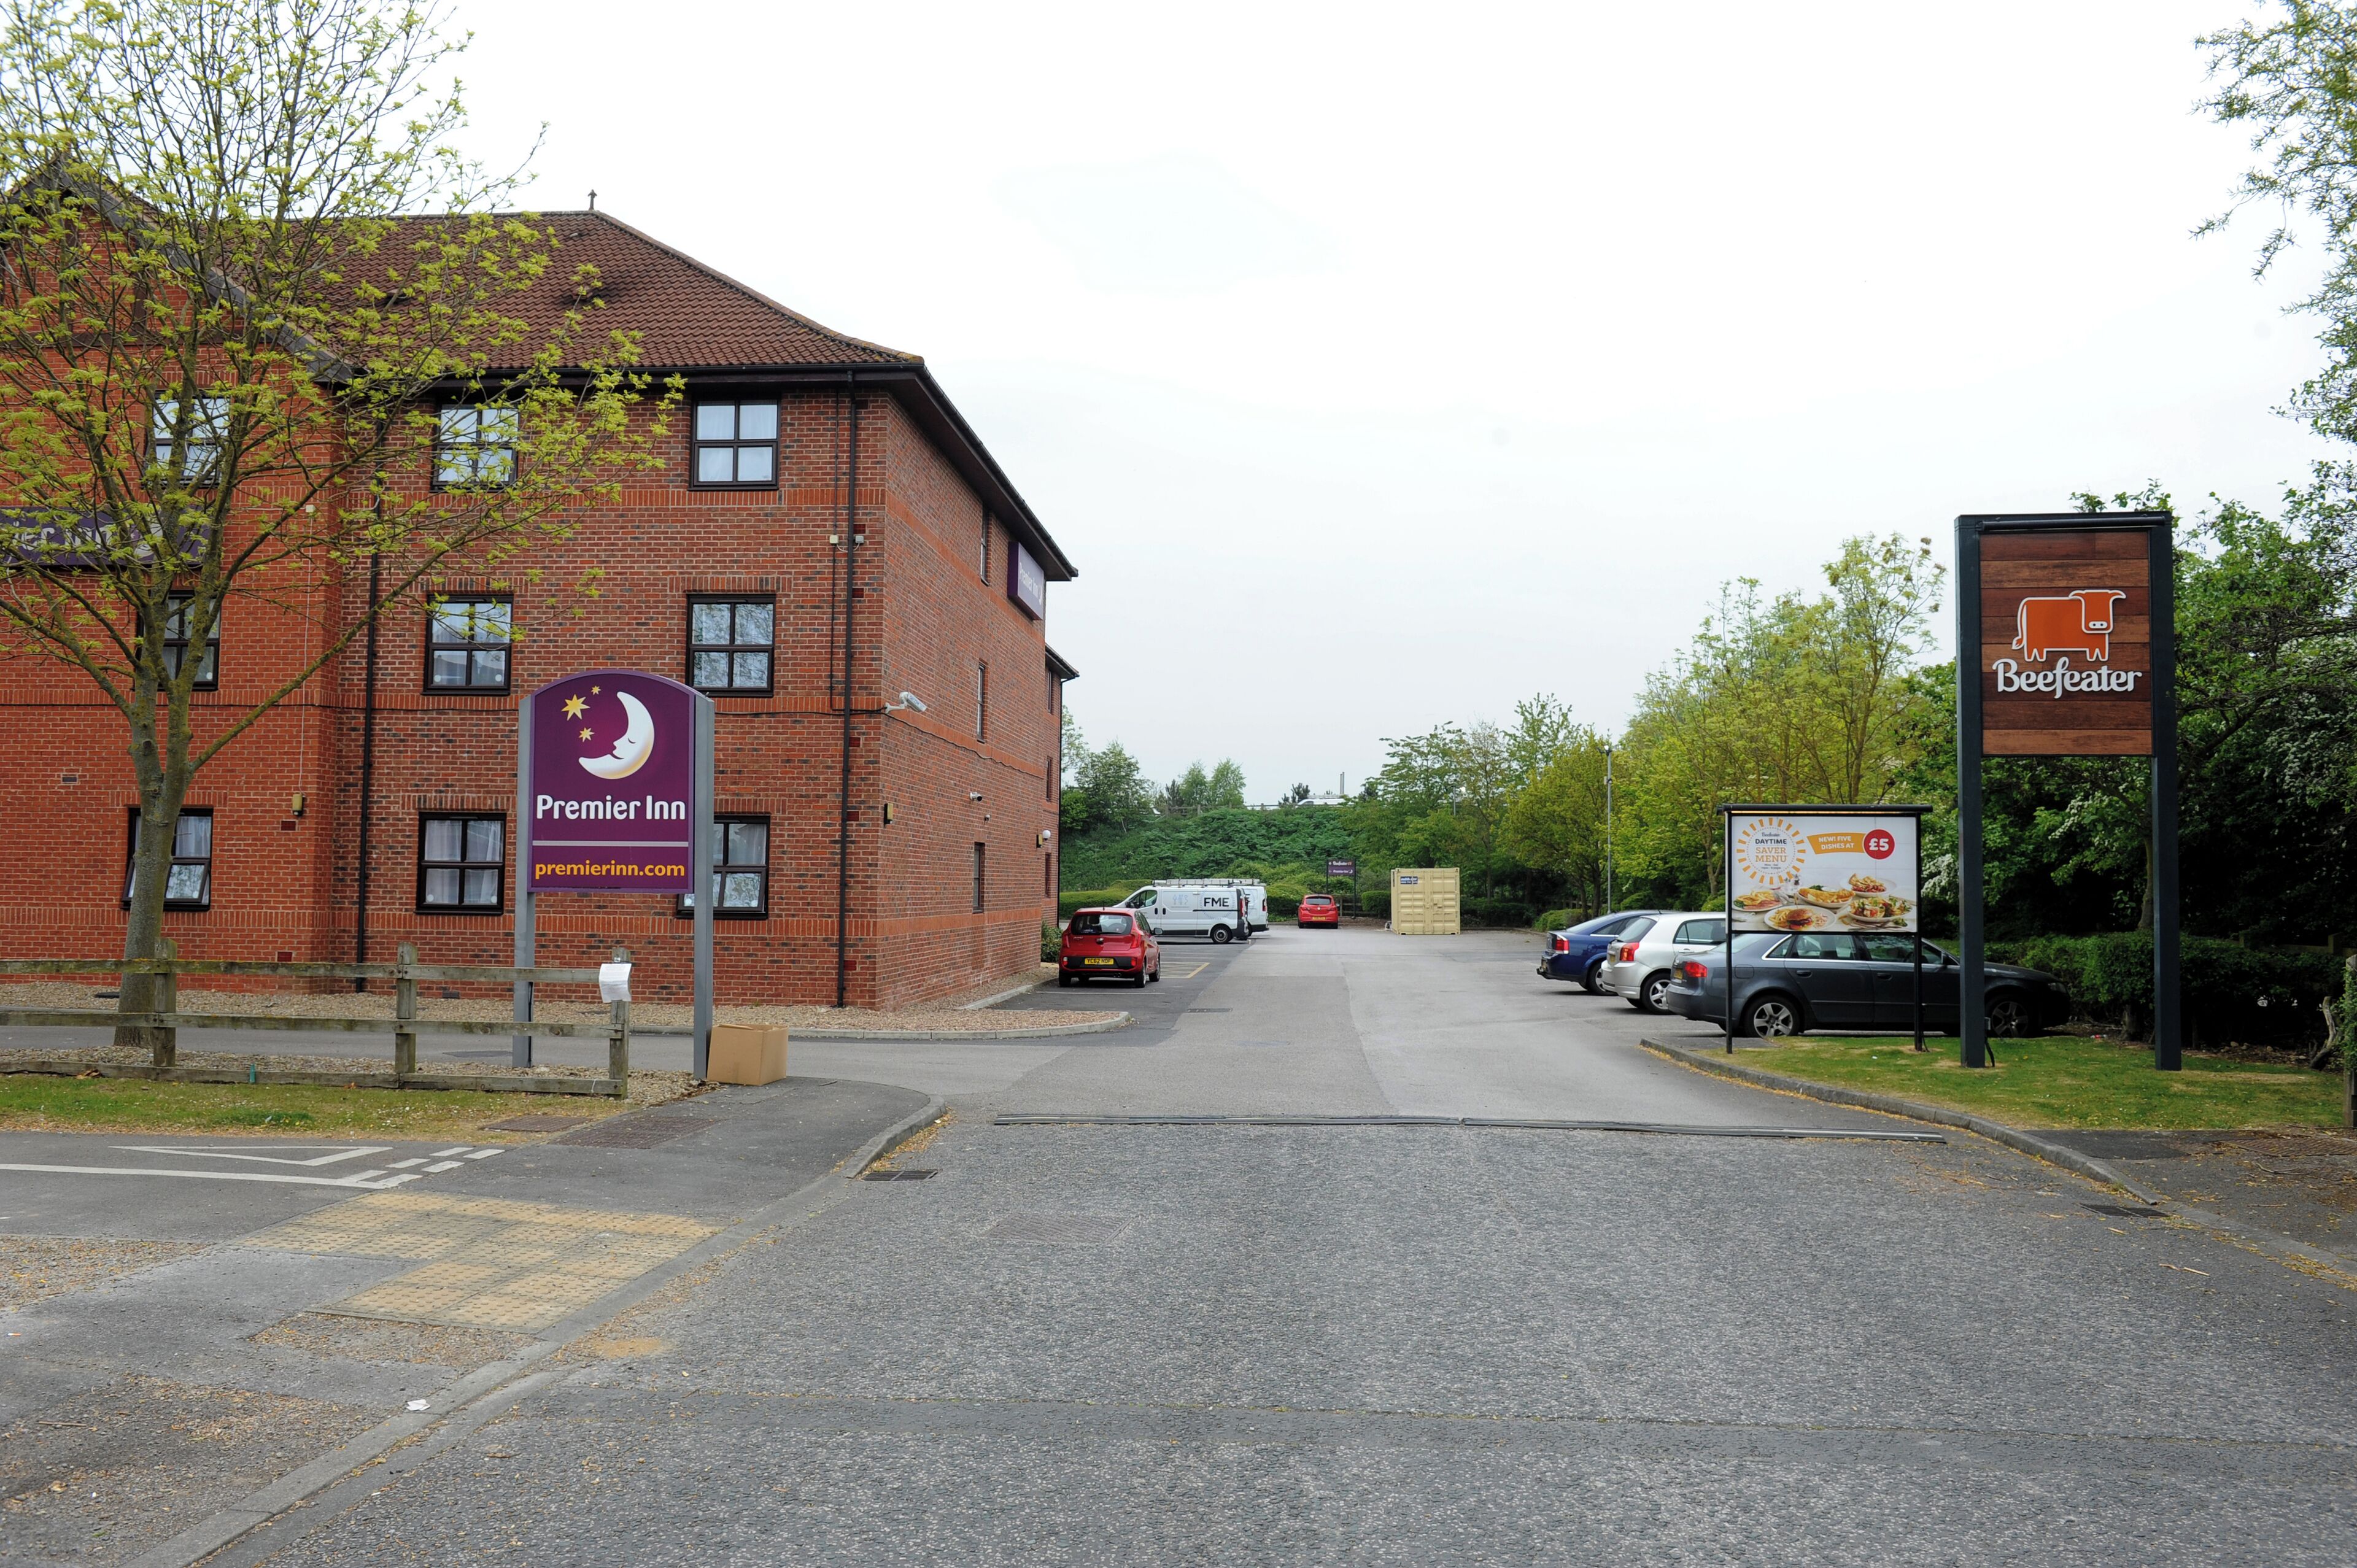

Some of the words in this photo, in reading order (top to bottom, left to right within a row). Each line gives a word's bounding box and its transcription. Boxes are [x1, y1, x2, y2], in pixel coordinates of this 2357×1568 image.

[1992, 656, 2142, 699] Beefeater
[536, 795, 641, 820] Premier
[646, 795, 686, 820] Inn
[1868, 838, 1889, 851] £5
[535, 860, 685, 879] premierinn.com
[1204, 897, 1229, 907] FME
